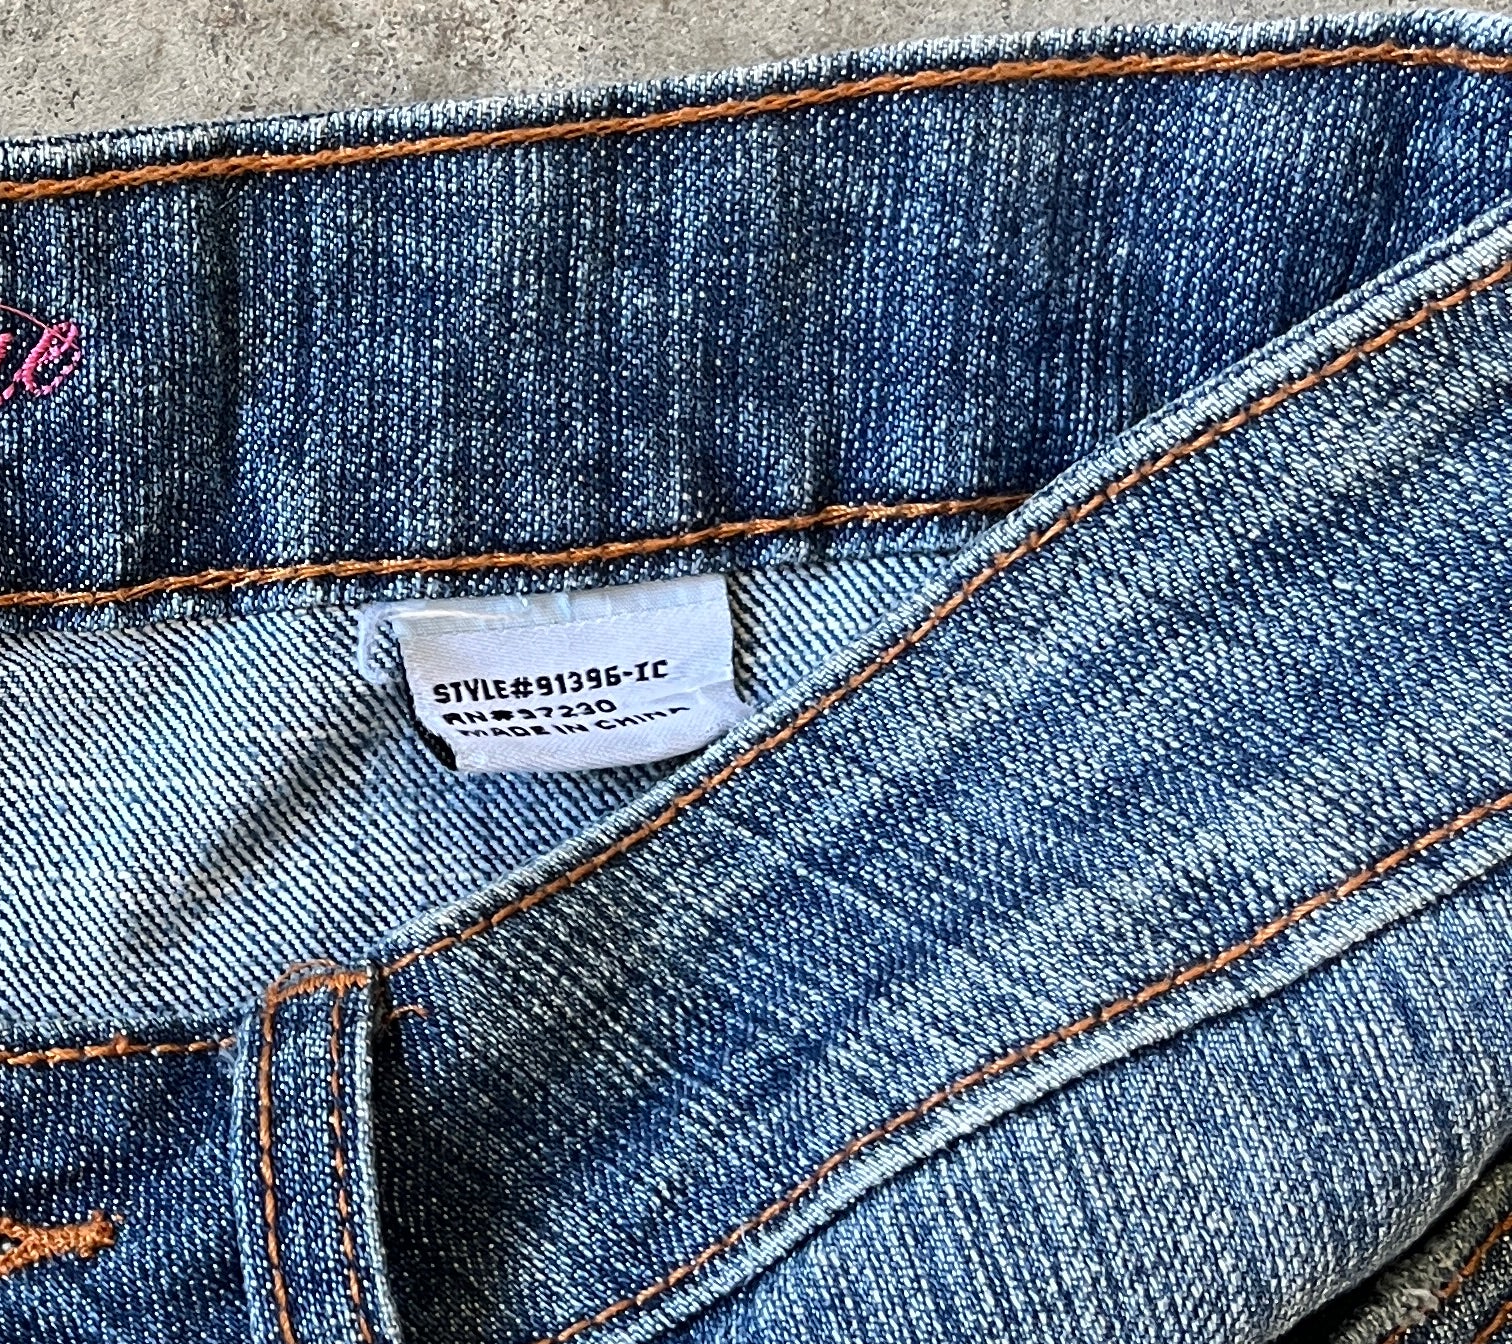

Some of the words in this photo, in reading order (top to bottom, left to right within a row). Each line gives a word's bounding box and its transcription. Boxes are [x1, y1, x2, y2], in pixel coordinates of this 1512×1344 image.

[456, 724, 551, 738] MADE
[551, 723, 590, 735] IN
[594, 706, 692, 731] CHINA
